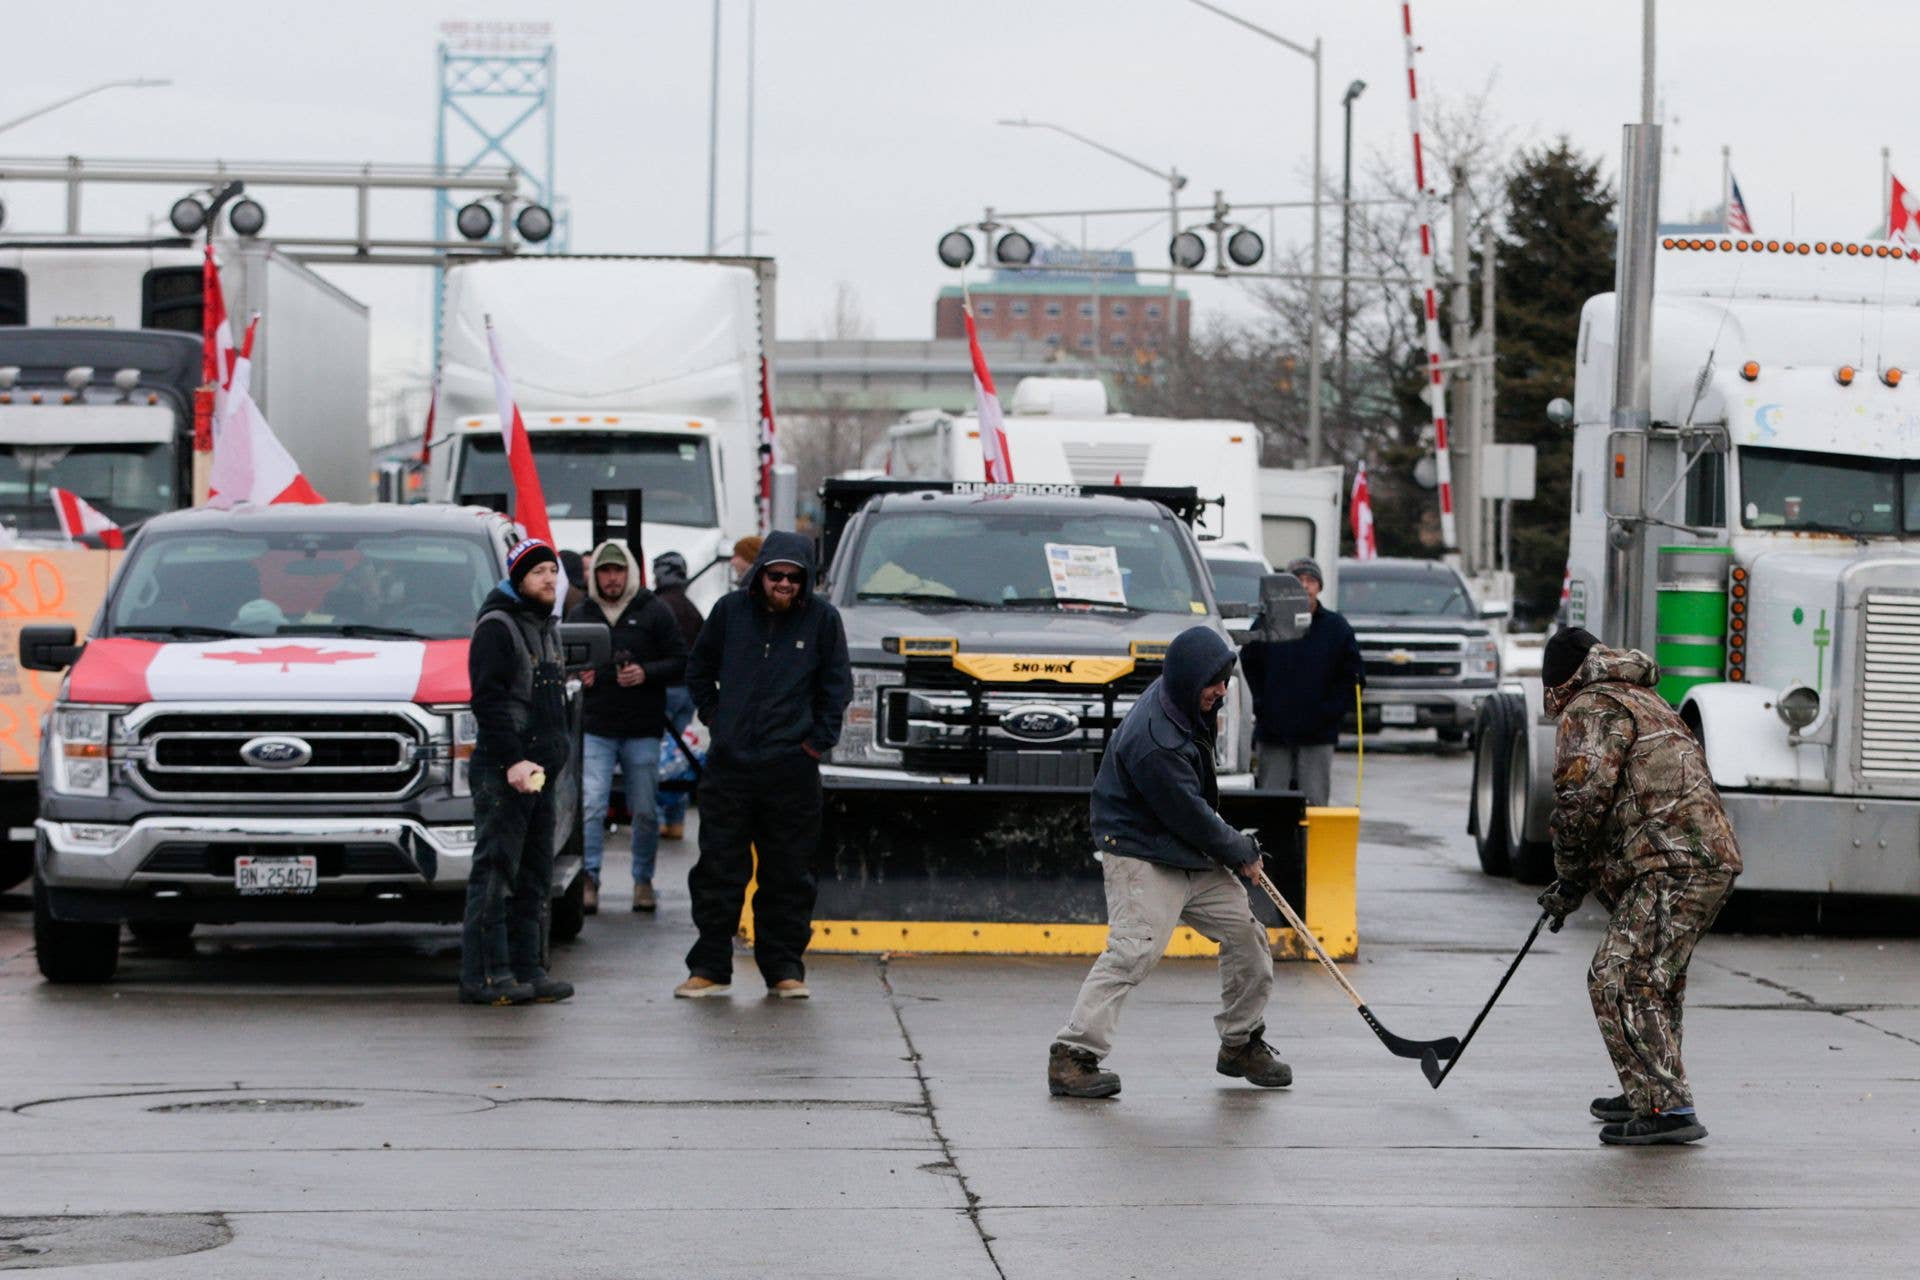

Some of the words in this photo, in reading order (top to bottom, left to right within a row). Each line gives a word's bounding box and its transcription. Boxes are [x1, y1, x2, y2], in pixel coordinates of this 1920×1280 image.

[1013, 660, 1077, 674] SNO-WAY
[1020, 713, 1059, 731] Ford
[261, 743, 295, 760] Ford
